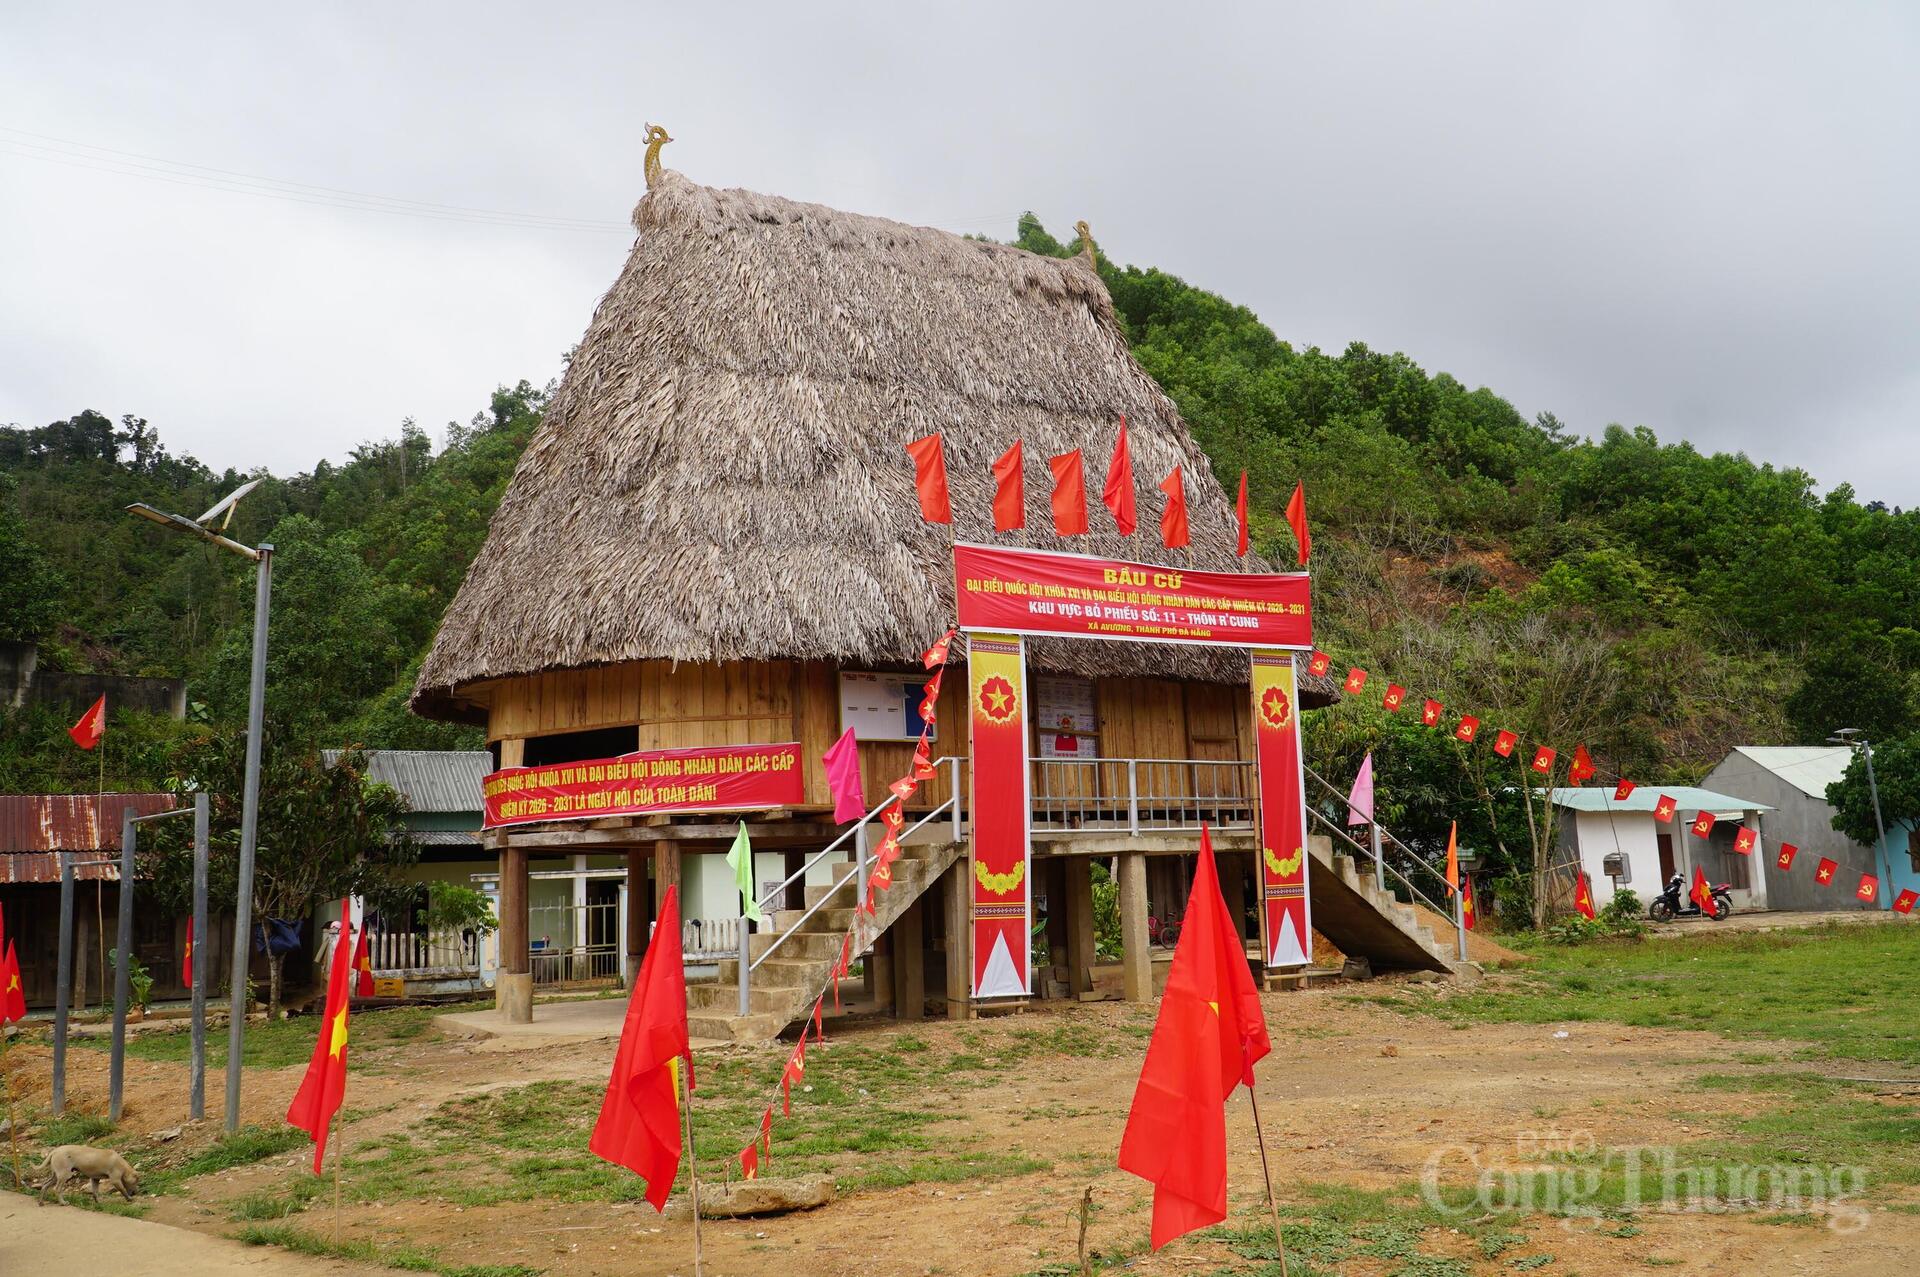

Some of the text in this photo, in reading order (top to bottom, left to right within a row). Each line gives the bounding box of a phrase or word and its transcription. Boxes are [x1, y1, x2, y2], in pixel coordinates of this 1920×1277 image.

[1104, 566, 1183, 589] BẦU CỬ
[966, 578, 981, 594] ĐẠI
[984, 576, 1003, 593] BIỂU
[1006, 578, 1028, 596] QUỐC
[1029, 582, 1043, 598] HỘI
[1068, 587, 1080, 599] XVI
[1094, 590, 1107, 603] ĐẠI
[1108, 587, 1125, 603] BIỂU
[1127, 591, 1140, 607] HỘI
[1290, 604, 1305, 614] 2031
[1029, 601, 1054, 614] KHU
[1058, 603, 1082, 618] VỰC
[1085, 603, 1101, 618] BỎ
[1104, 606, 1138, 620] PHIẾU
[1142, 607, 1160, 622] SỐ:
[1163, 612, 1176, 622] 11
[1187, 612, 1216, 626] THÔN
[525, 771, 538, 791] HỘI
[540, 768, 559, 787] KHÓA
[562, 769, 574, 785] XVI
[576, 764, 587, 782] VÀ
[590, 766, 604, 784] ĐẠI
[607, 758, 628, 780] BIỂU
[632, 759, 648, 781] HỘI
[651, 756, 680, 777] ĐỒNG
[684, 755, 716, 775] NHÂN
[719, 754, 742, 774] DÂN
[746, 753, 768, 772] CÁC
[772, 749, 794, 771] CẤP
[528, 798, 546, 814] 2026
[554, 796, 572, 812] 2031
[576, 791, 586, 810] LÀ
[588, 789, 611, 808] NGÀY
[614, 788, 630, 809] HỘI
[634, 784, 654, 806] CỦA
[657, 784, 686, 803] TOÀN
[690, 783, 716, 802] DÂN!
